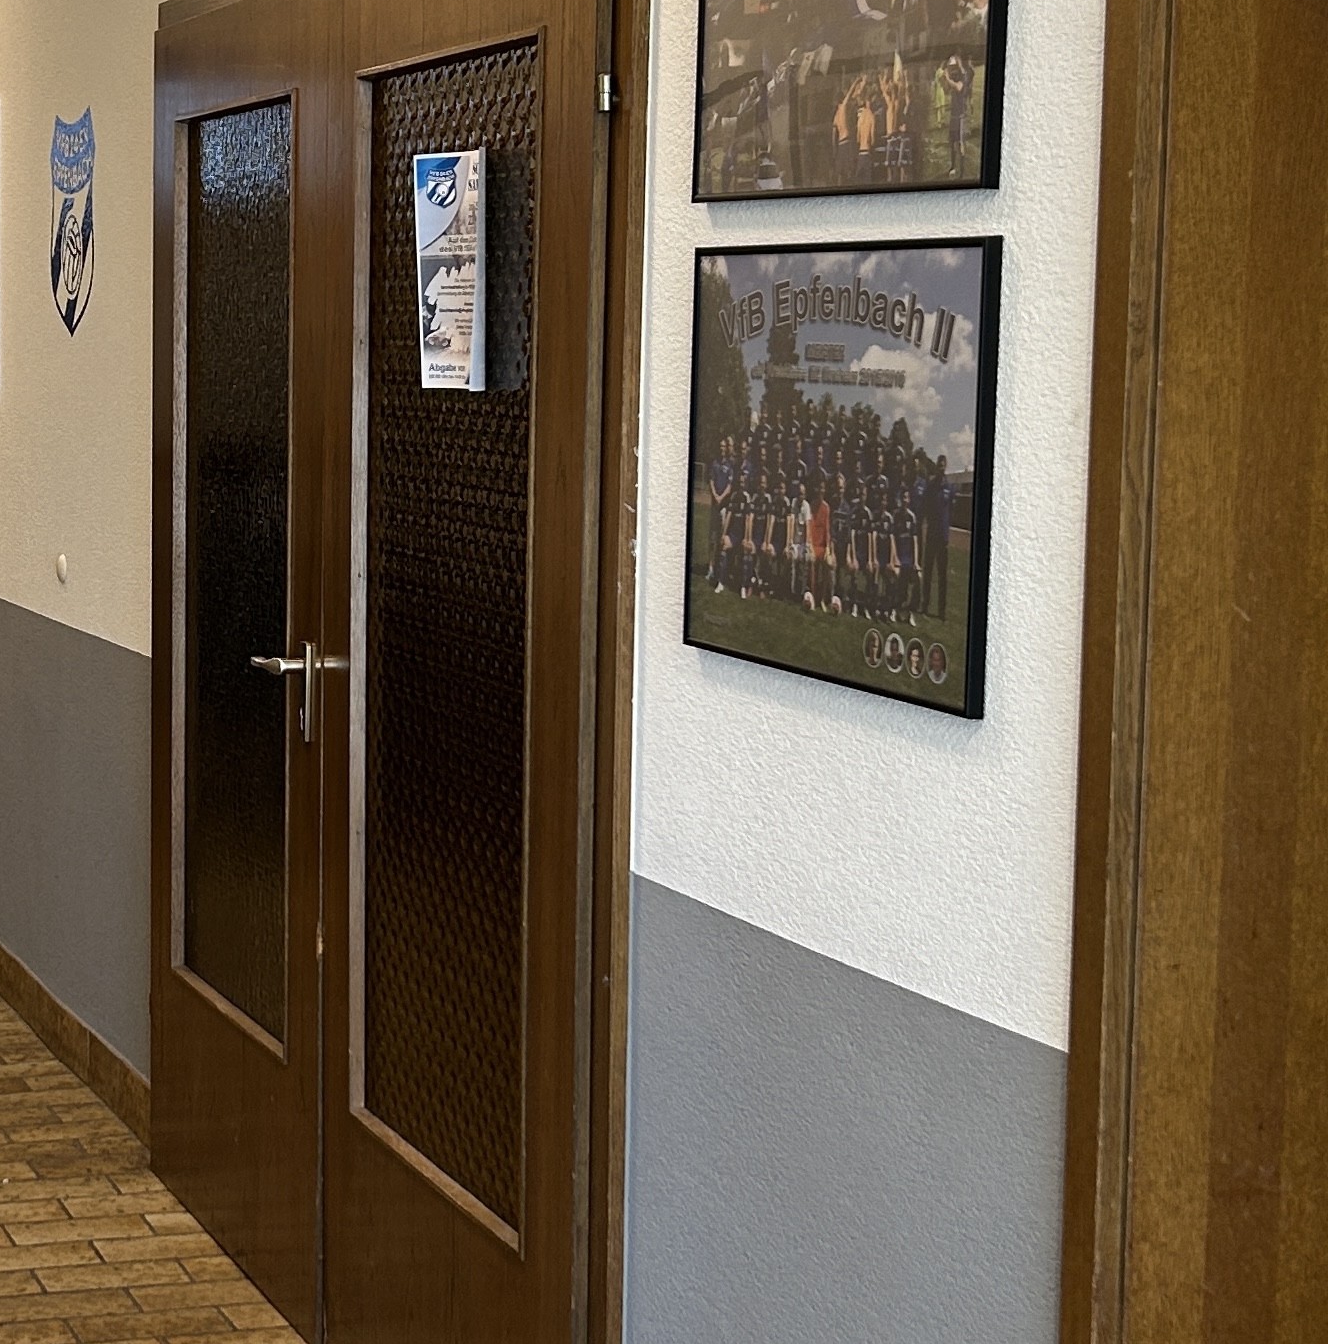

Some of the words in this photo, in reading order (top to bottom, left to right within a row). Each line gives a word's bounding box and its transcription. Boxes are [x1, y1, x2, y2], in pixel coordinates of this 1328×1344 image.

[718, 289, 766, 348] VfB
[773, 273, 925, 350] Epfenbach
[930, 305, 957, 363] II
